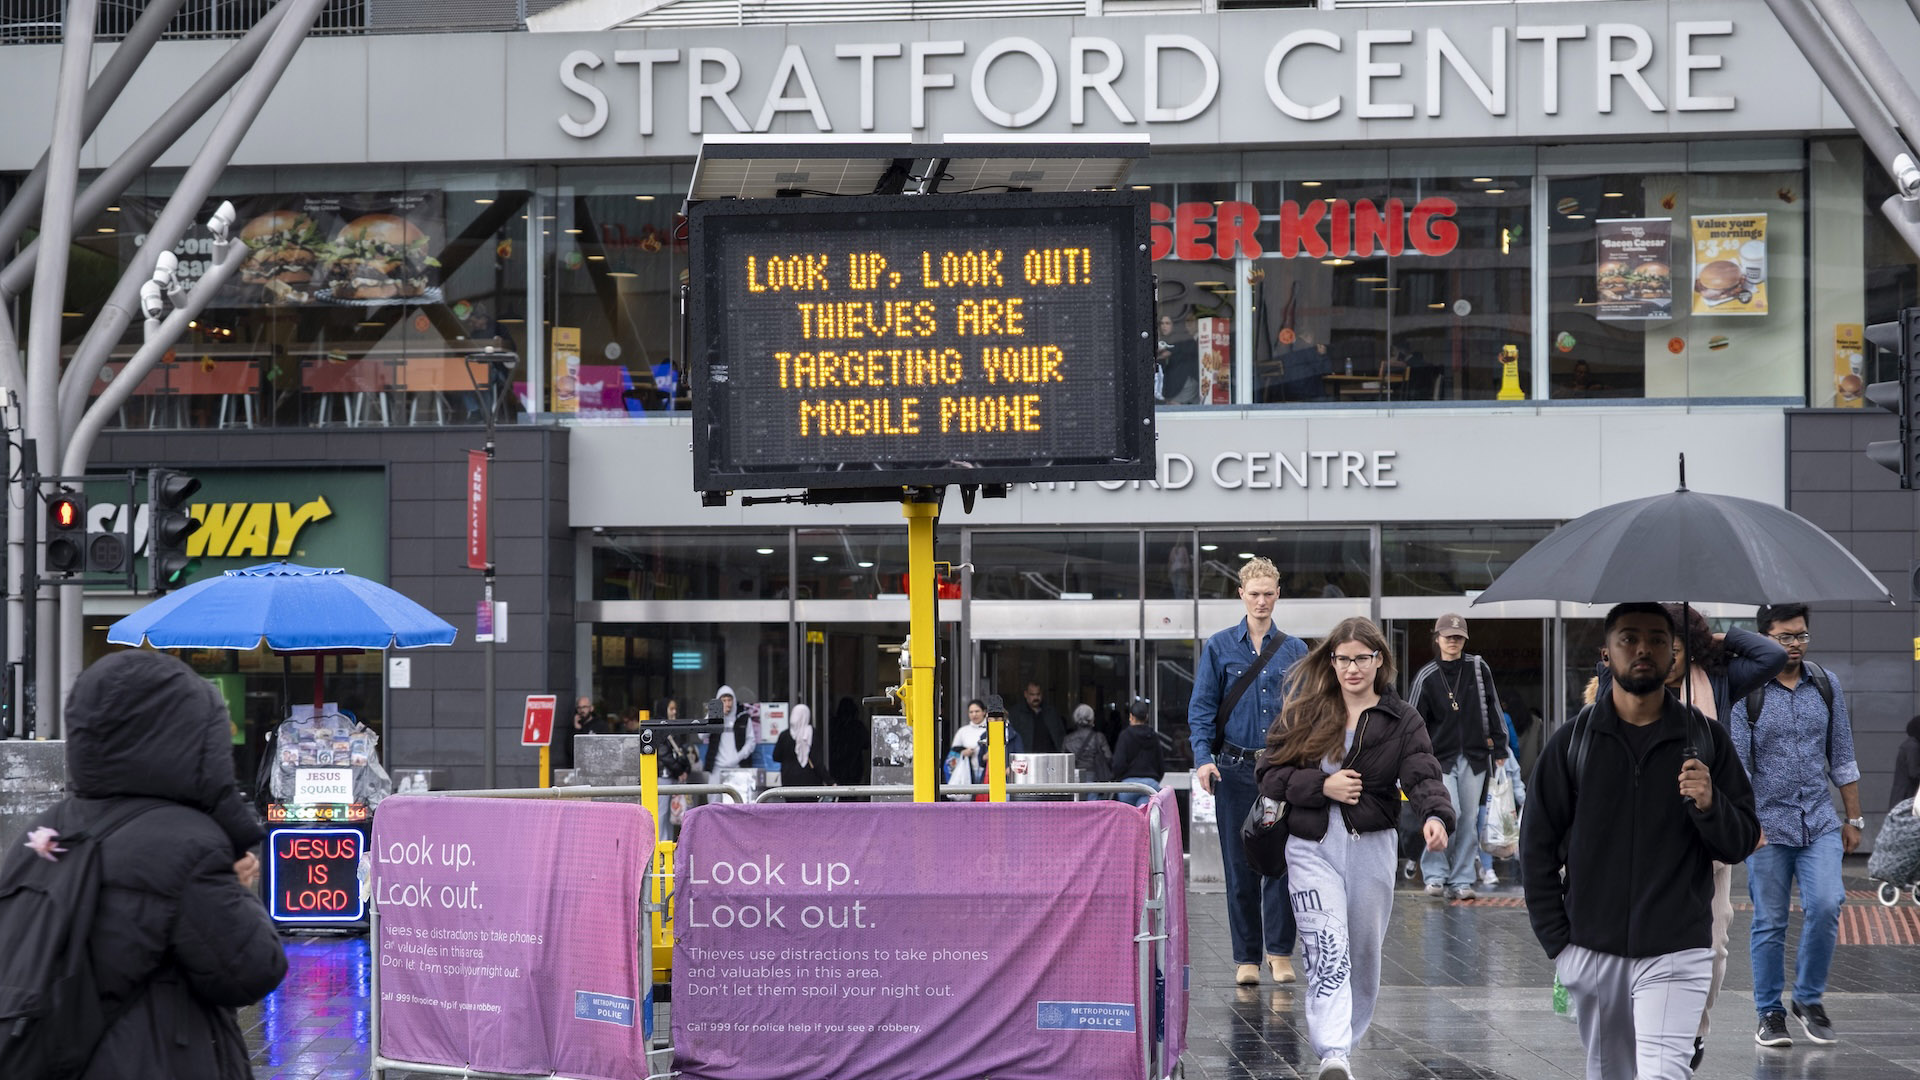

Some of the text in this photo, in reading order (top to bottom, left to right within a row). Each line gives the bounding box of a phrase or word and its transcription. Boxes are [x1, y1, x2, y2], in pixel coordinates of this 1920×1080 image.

[557, 20, 1736, 138] STRATFORD CENTRE
[1280, 197, 1459, 259] KING
[1697, 219, 1756, 231] Value your
[1710, 228, 1763, 240] mornings
[747, 247, 1091, 292] LOOK UP, LOOK OUT!
[798, 298, 1025, 339] THIEVES ARE
[775, 345, 1064, 388] TARGETING YOUR
[799, 395, 1041, 437] MOBILE PHONE
[1211, 450, 1398, 490] CENTRE
[306, 772, 341, 781] JESUS
[300, 785, 347, 795] SQUARE
[279, 838, 355, 860] JESUS
[377, 834, 476, 872] Look up.
[307, 863, 329, 885] IS
[690, 854, 860, 892] Look up.
[286, 889, 348, 911] LORD
[376, 876, 483, 910] Look out.
[690, 898, 876, 929] Look out.
[480, 931, 489, 941] to
[491, 930, 508, 942] take
[509, 930, 543, 945] phones
[440, 945, 449, 957] in
[451, 945, 465, 958] this
[689, 947, 989, 963] Thieves use distractions to take phones
[481, 964, 503, 979] night
[503, 966, 521, 979] out.
[688, 965, 883, 979] and valuables in this area.
[396, 993, 410, 1003] 999
[733, 983, 753, 996] let
[757, 983, 797, 996] them
[801, 983, 837, 998] spoil
[842, 986, 877, 999] your
[881, 984, 920, 999] night
[925, 985, 955, 997] out.
[1070, 1007, 1130, 1017] METROPOLITAN
[1079, 1017, 1122, 1026] POLICE
[686, 1022, 922, 1034] Call 999 for police help if you see a robbery.
